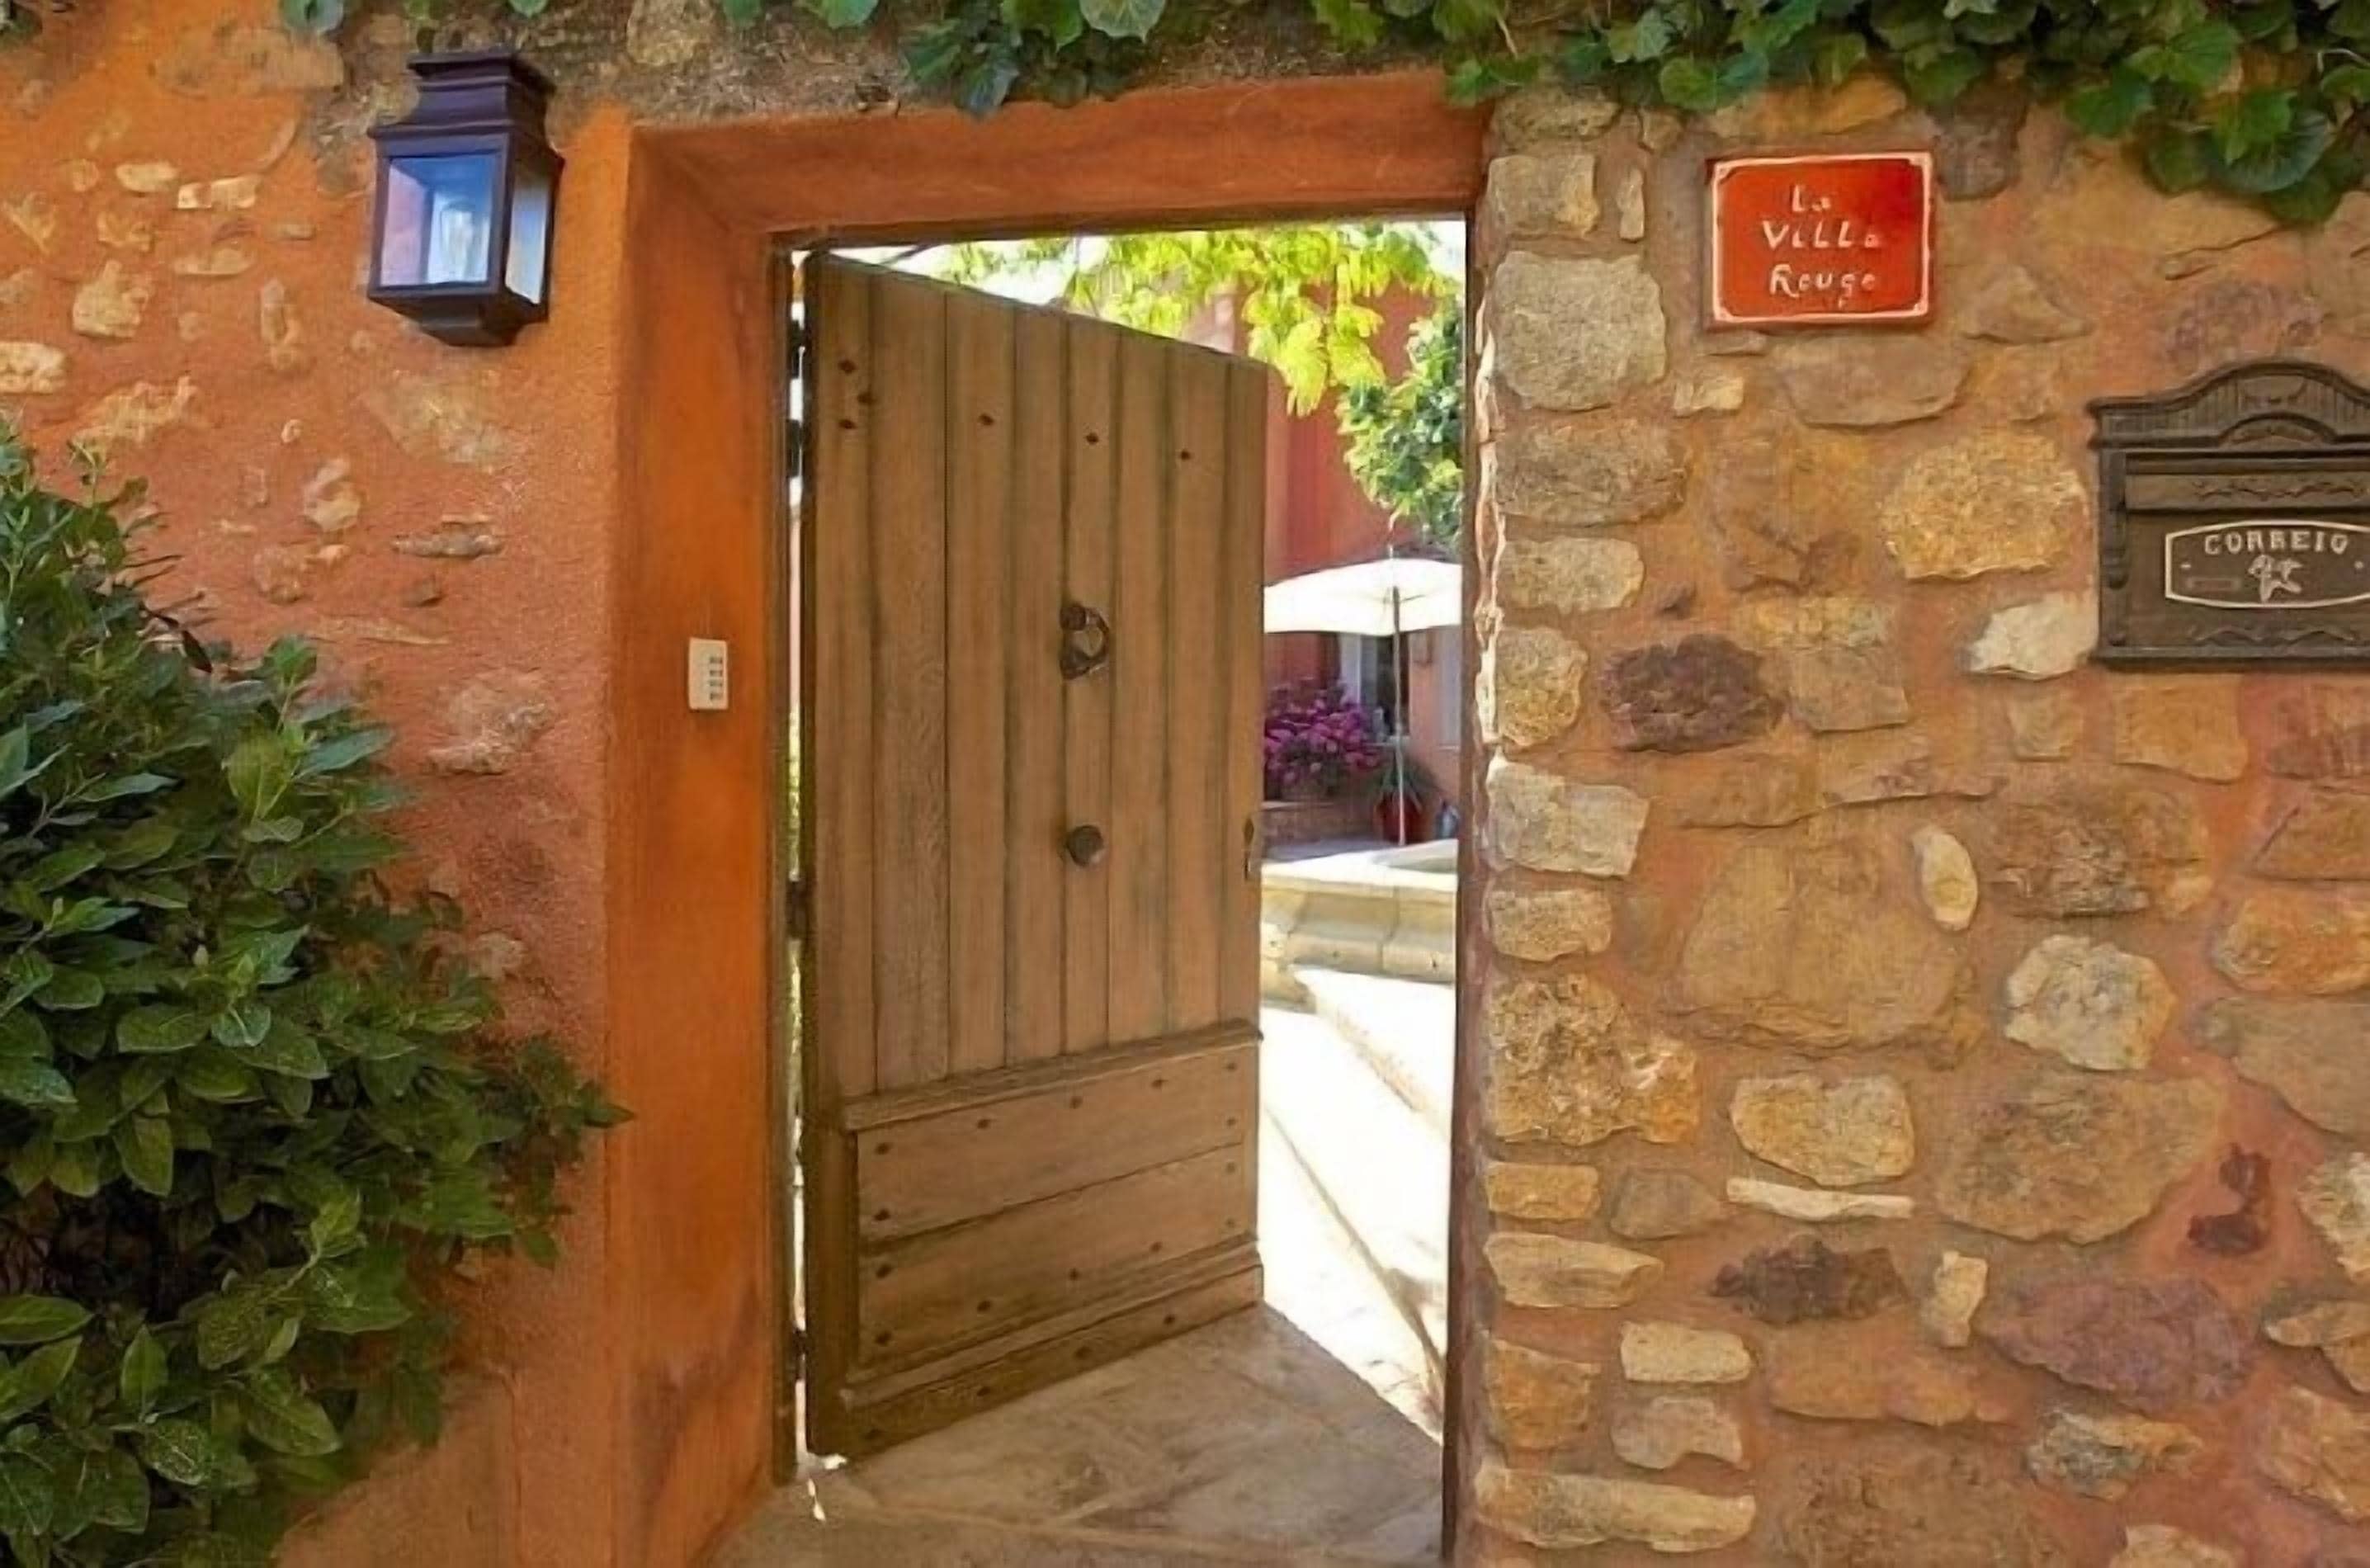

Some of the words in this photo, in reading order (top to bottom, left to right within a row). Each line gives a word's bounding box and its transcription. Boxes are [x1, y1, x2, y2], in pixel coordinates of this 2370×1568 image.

[1791, 184, 1831, 212] La
[1769, 263, 1877, 309] Rouge
[2204, 530, 2349, 555] CORREIO
